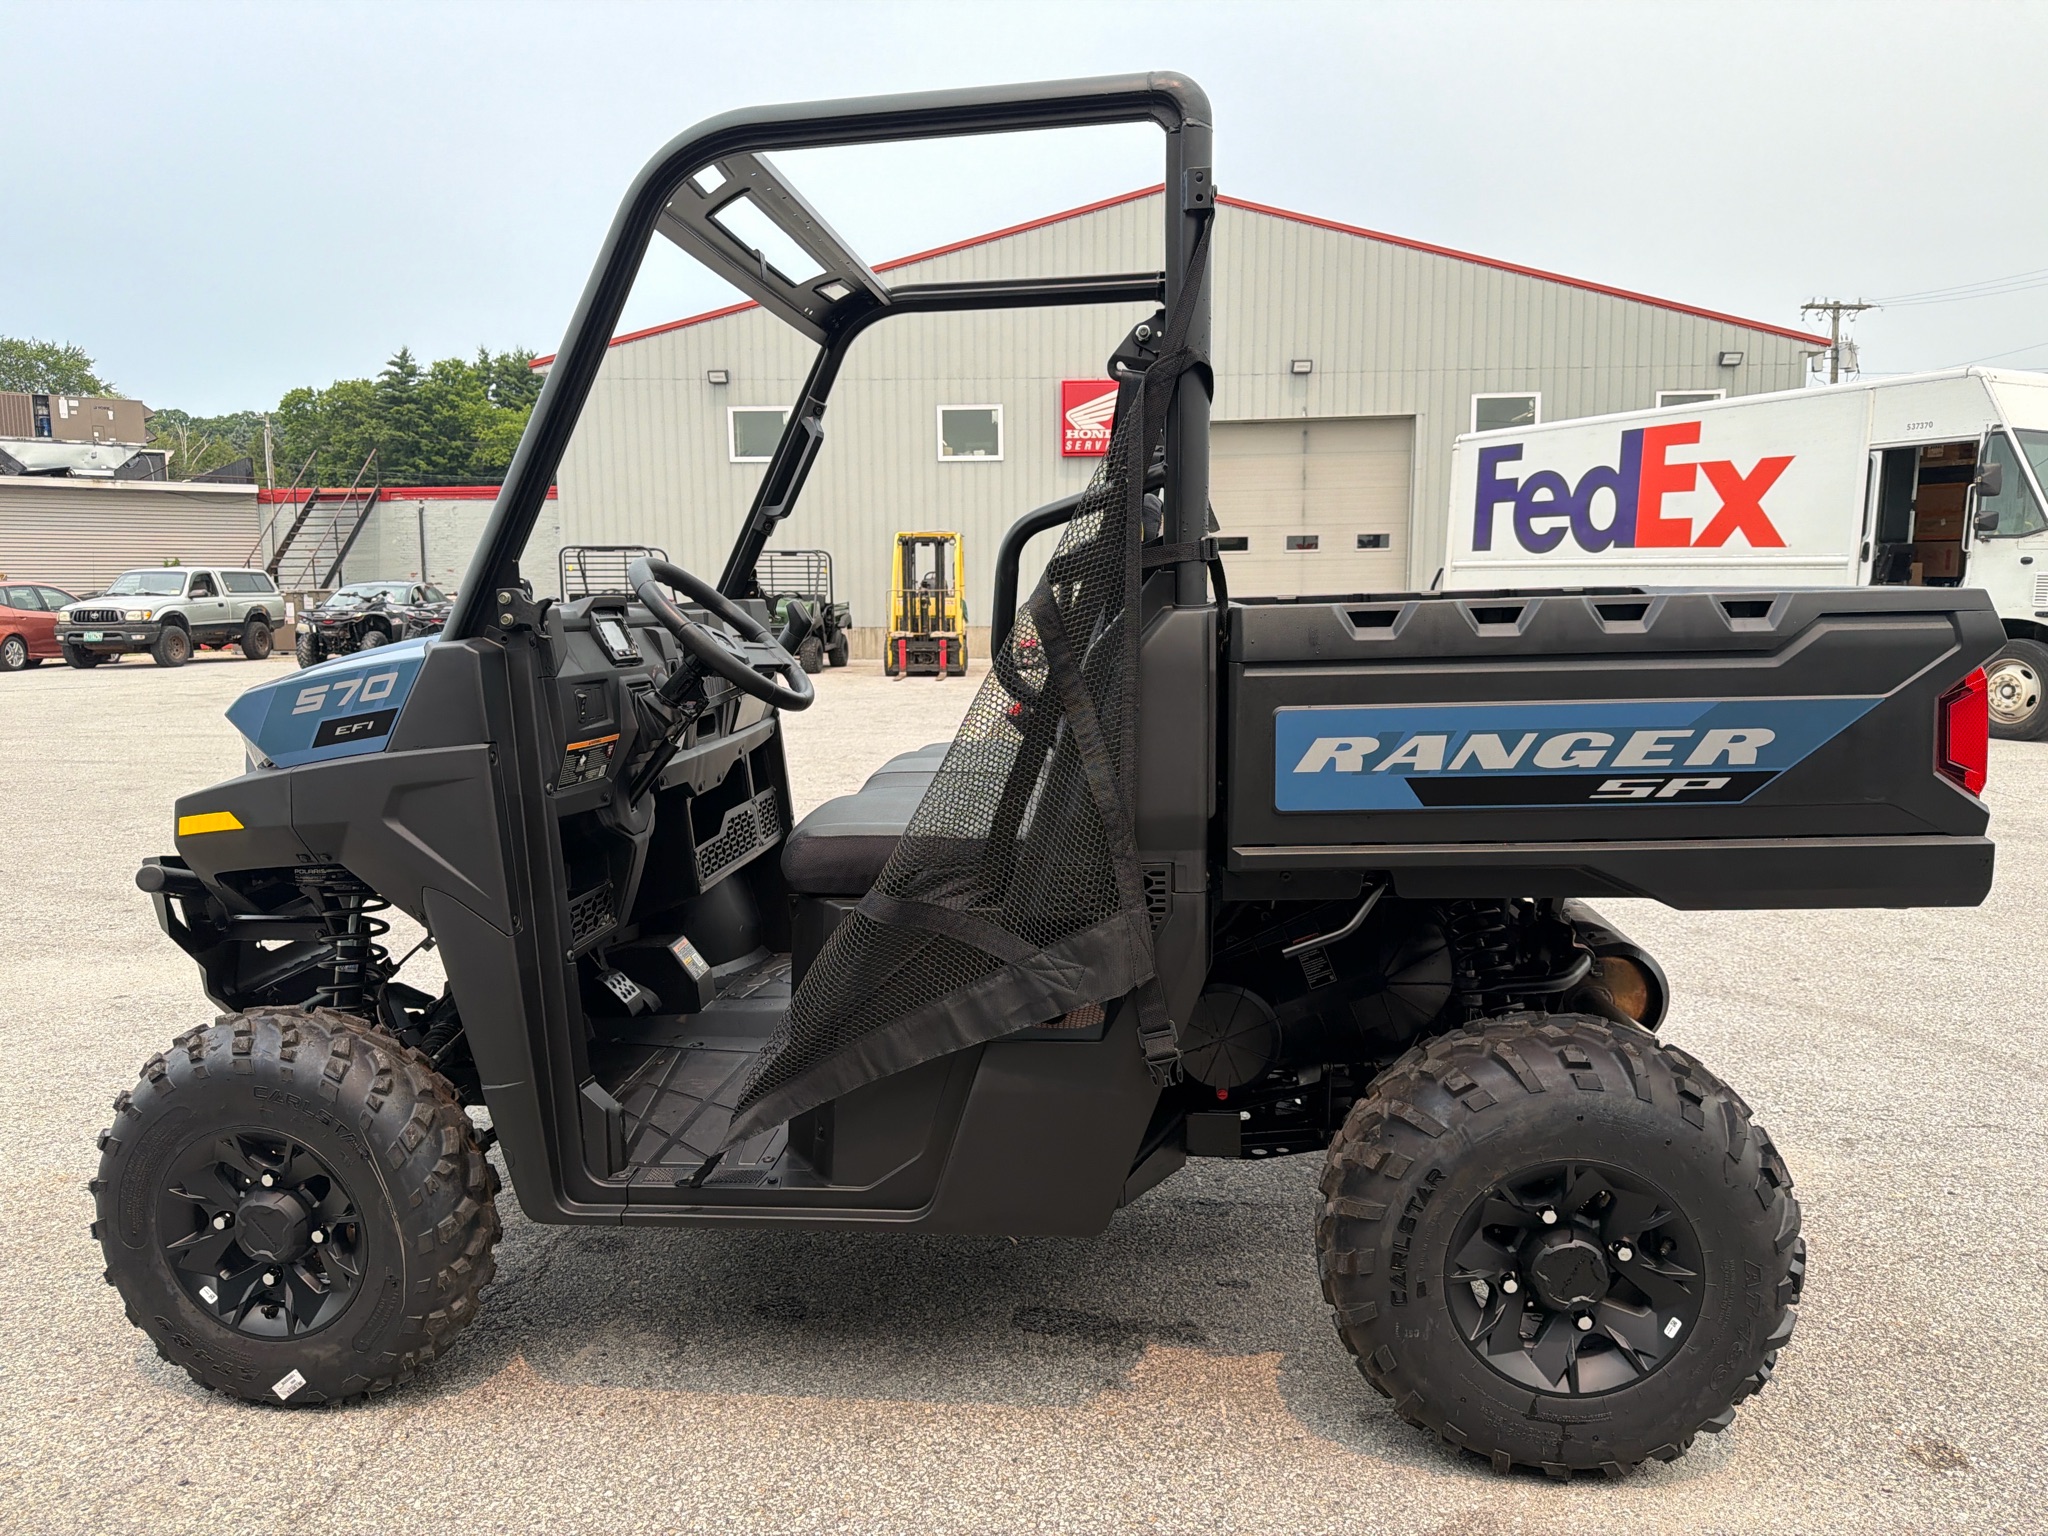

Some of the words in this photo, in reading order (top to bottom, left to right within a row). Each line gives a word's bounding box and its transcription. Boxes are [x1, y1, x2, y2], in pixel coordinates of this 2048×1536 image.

[1065, 429, 1111, 439] HON
[1906, 421, 1934, 431] 537370
[1472, 420, 1796, 554] FedEx
[292, 671, 399, 716] 570
[334, 720, 374, 736] EFI
[1293, 728, 1777, 773] RANGER
[1589, 777, 1731, 799] SP
[253, 1085, 371, 1161] CARLSTAR
[1390, 1168, 1447, 1307] CARLSTAR
